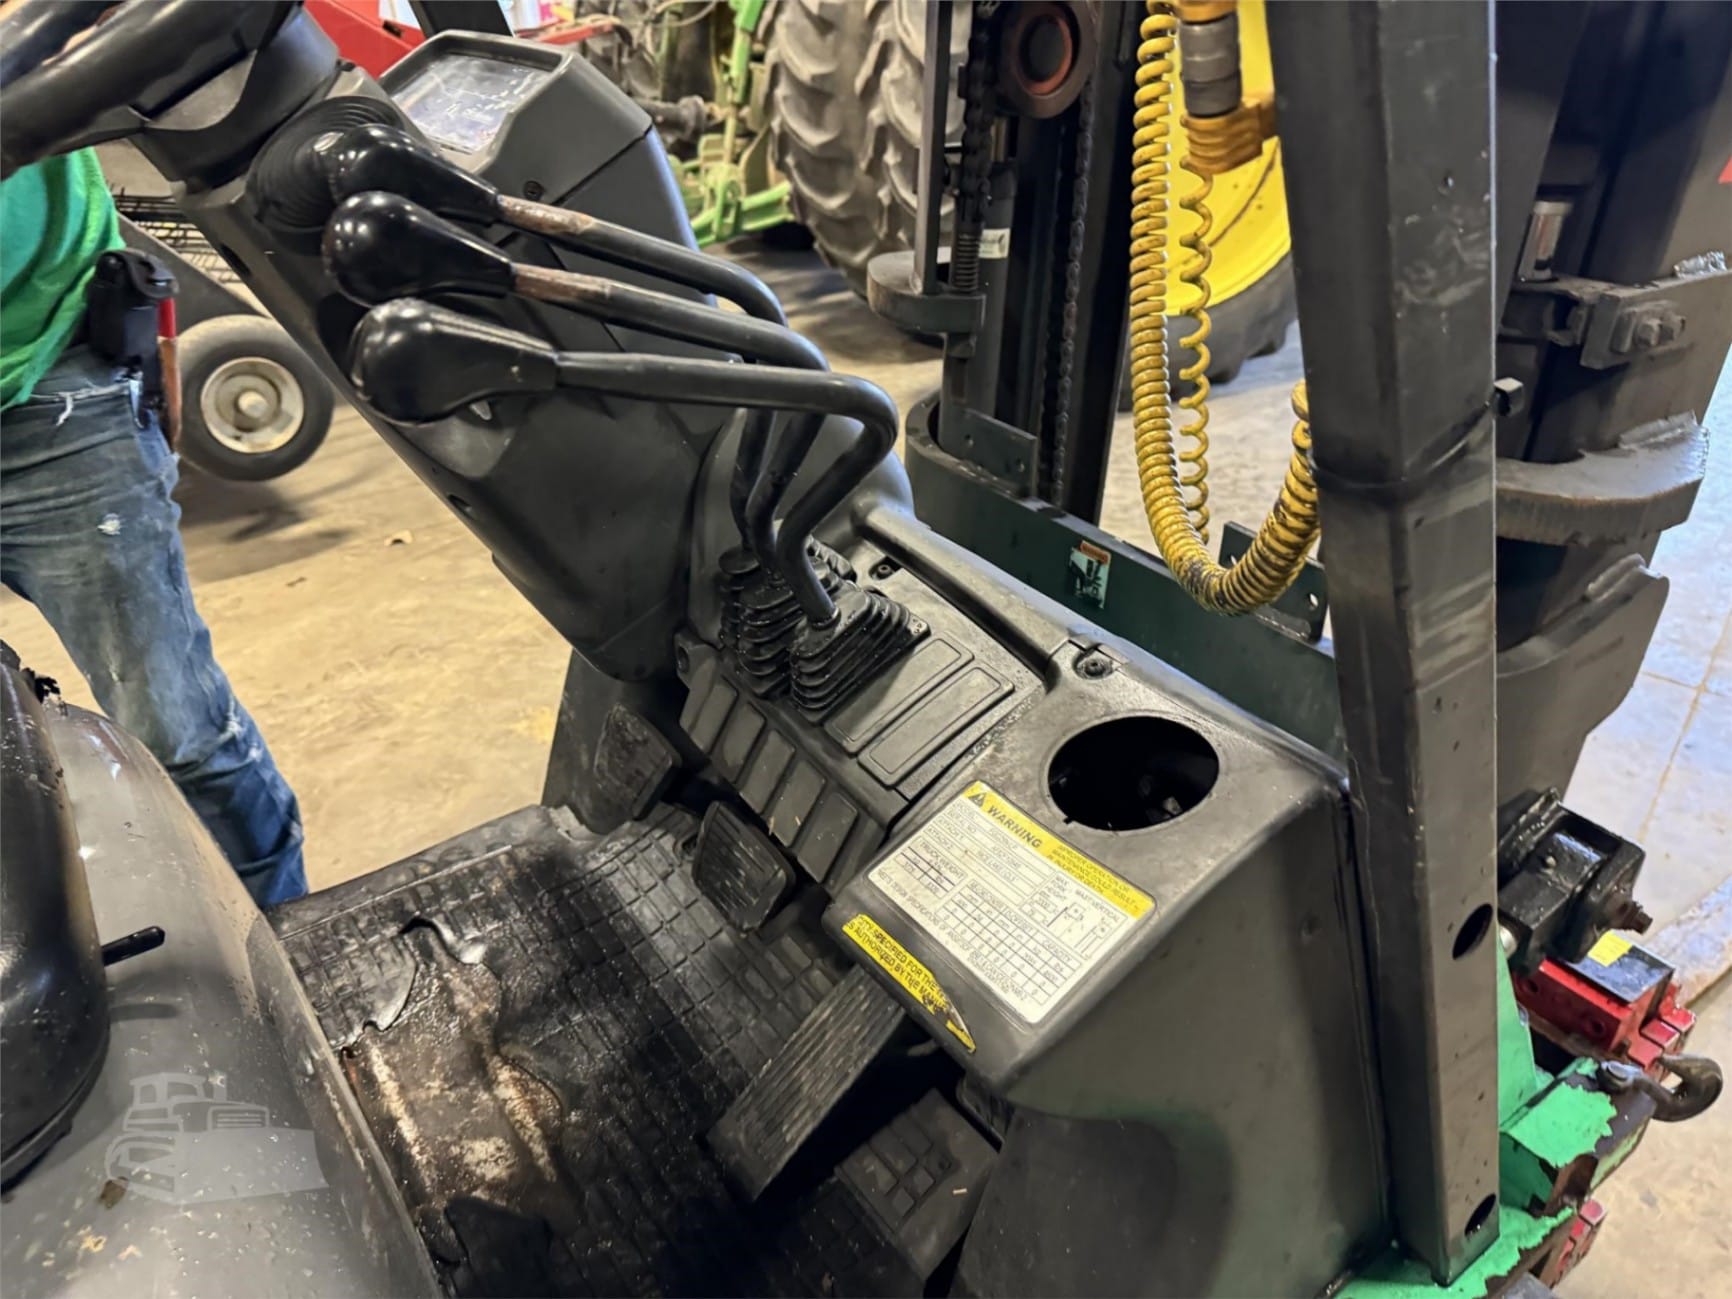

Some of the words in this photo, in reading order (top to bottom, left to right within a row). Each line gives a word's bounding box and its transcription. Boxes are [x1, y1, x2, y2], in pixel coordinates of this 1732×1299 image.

[987, 806, 1042, 848] WARNING
[918, 841, 942, 860] TRUCK
[939, 857, 963, 879] WEIGHT
[1052, 847, 1090, 877] MAINTENANCE
[1088, 872, 1112, 890] COULD
[1111, 887, 1136, 906] RESULT
[1086, 862, 1119, 887] OPERATION
[854, 925, 895, 967] AUTHORIZED
[893, 963, 907, 977] BY
[903, 972, 922, 991] THE
[871, 927, 908, 964] SPECIFIED
[904, 959, 923, 977] FOR
[920, 974, 938, 991] THE
[1042, 938, 1071, 963] CAPACITY
